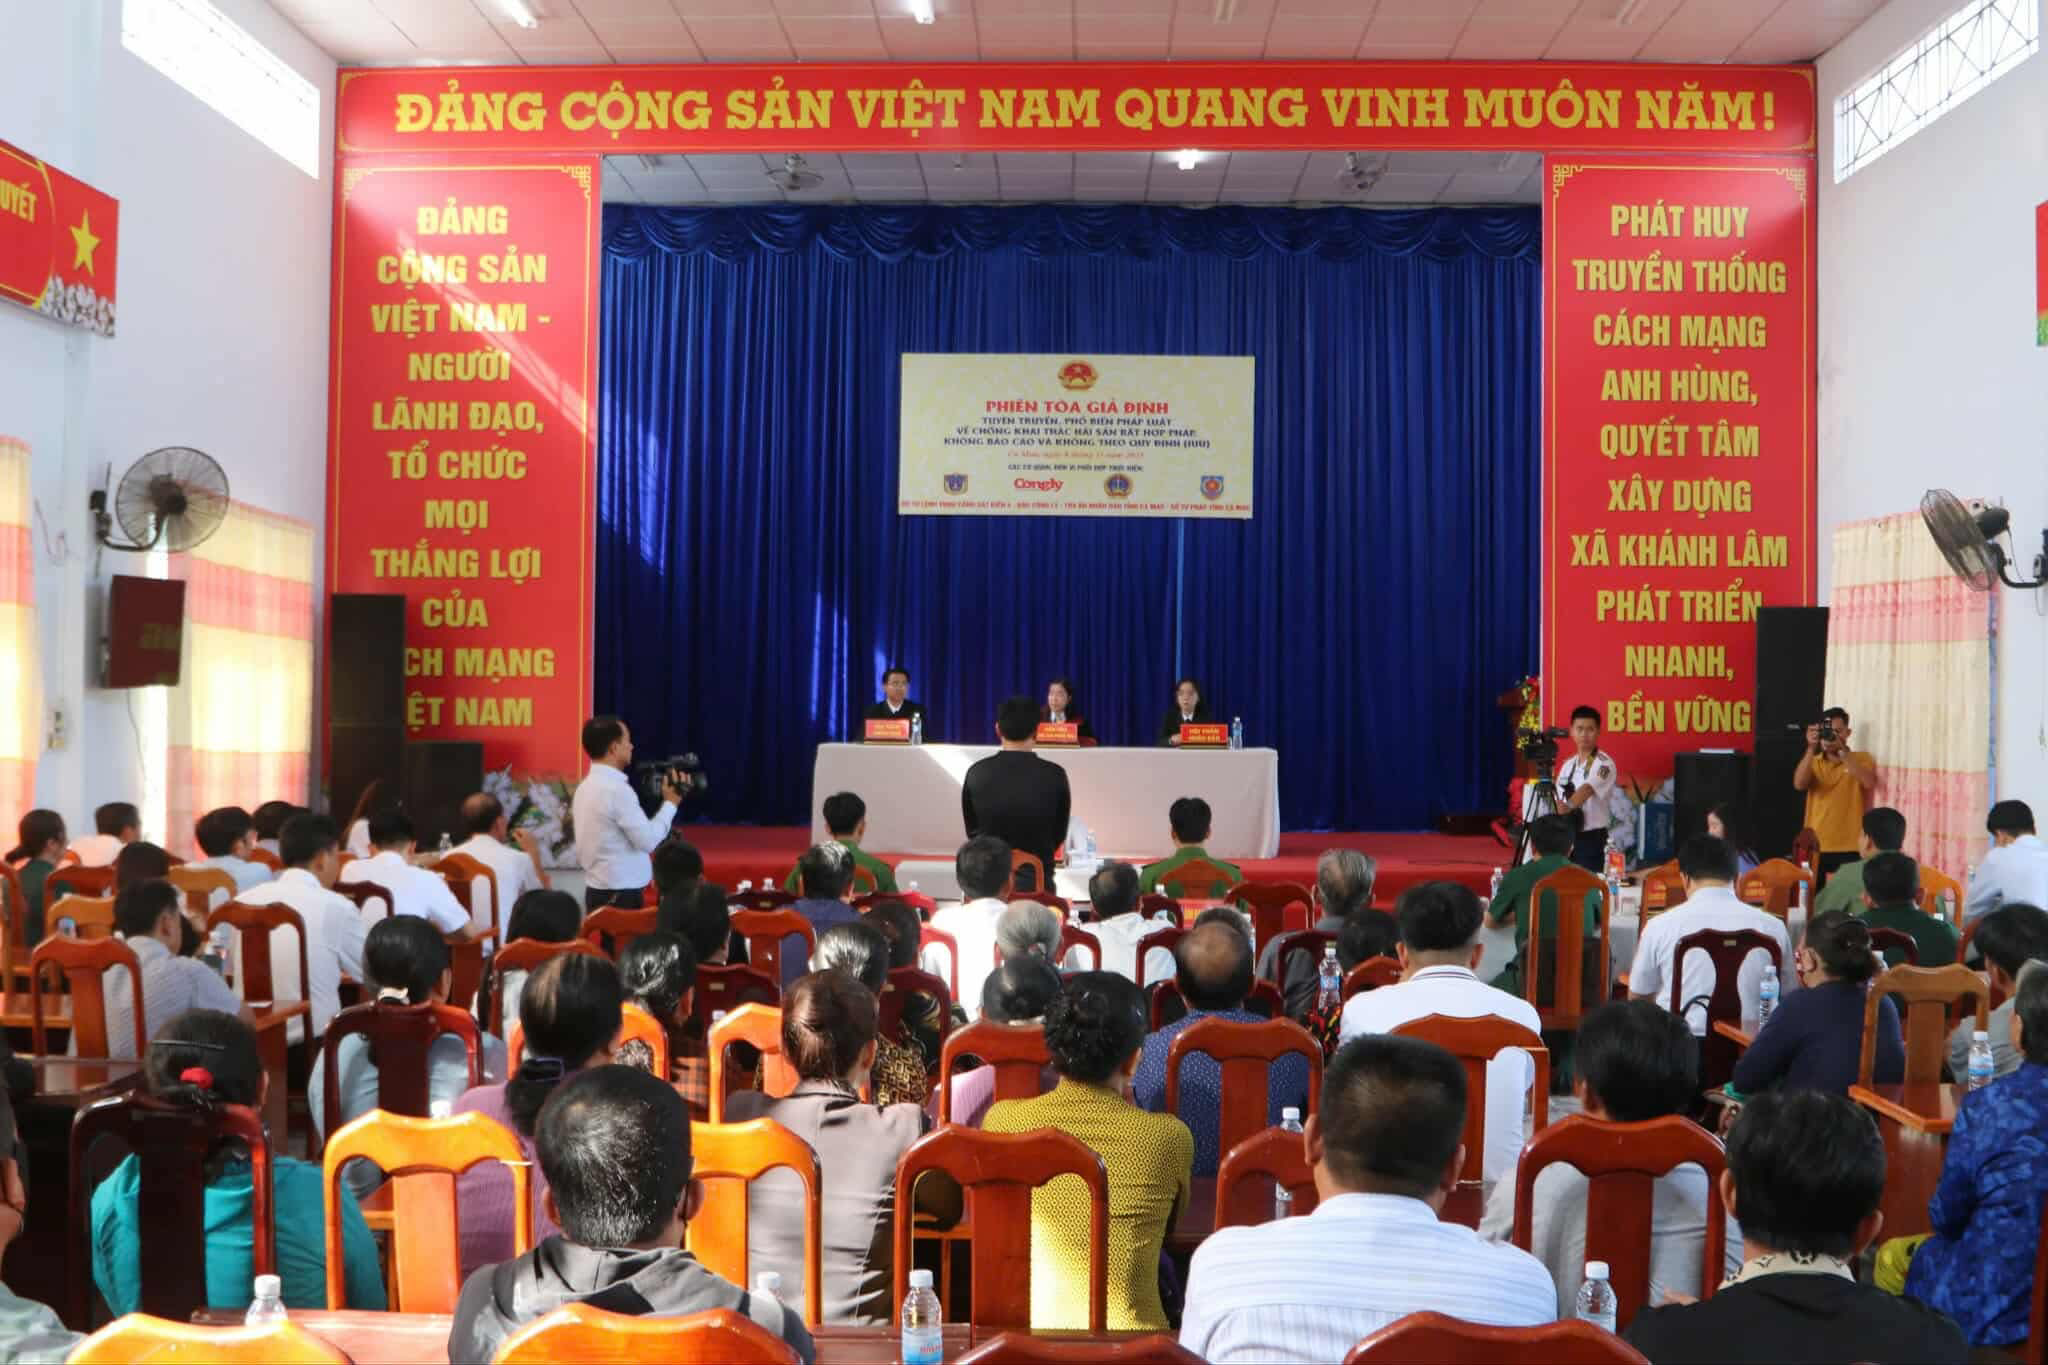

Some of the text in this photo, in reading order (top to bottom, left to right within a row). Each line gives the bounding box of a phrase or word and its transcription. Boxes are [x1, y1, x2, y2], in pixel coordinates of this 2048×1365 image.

[395, 77, 1775, 138] ĐẢNG CỘNG SẢN VIỆT NAM QUANG VINH MUÔN NĂM!
[0, 177, 37, 224] UYẾT
[416, 197, 508, 235] ĐẢNG
[1610, 200, 1749, 237] PHÁT HUY
[377, 245, 547, 290] CỘNG SẢN
[1572, 250, 1787, 293] TRUYỀN THỐNG
[371, 297, 440, 339] VIỆT
[449, 302, 527, 332] NAM
[1593, 309, 1767, 354] CÁCH MẠNG
[408, 345, 511, 382] NGƯỜI
[1600, 364, 1758, 406] ANH HÙNG,
[373, 396, 545, 436] LÃNH ĐẠO,
[1600, 415, 1760, 459] QUYẾT TÂM
[388, 440, 528, 480] TỔ CHỨC
[1608, 473, 1752, 519] XÂY DỰNG
[425, 500, 489, 536] MỌI
[371, 540, 541, 583] THẮNG LỢI
[1571, 527, 1788, 567] XÃ KHÁNH LÂM
[422, 588, 488, 628] CỦA
[1596, 577, 1763, 622] PHÁT TRIỂN
[404, 647, 555, 680] CH MẠNG
[1624, 644, 1734, 680] NHANH,
[407, 690, 533, 732] ỆT NAM
[1606, 690, 1752, 732] BỀN VỮNG
